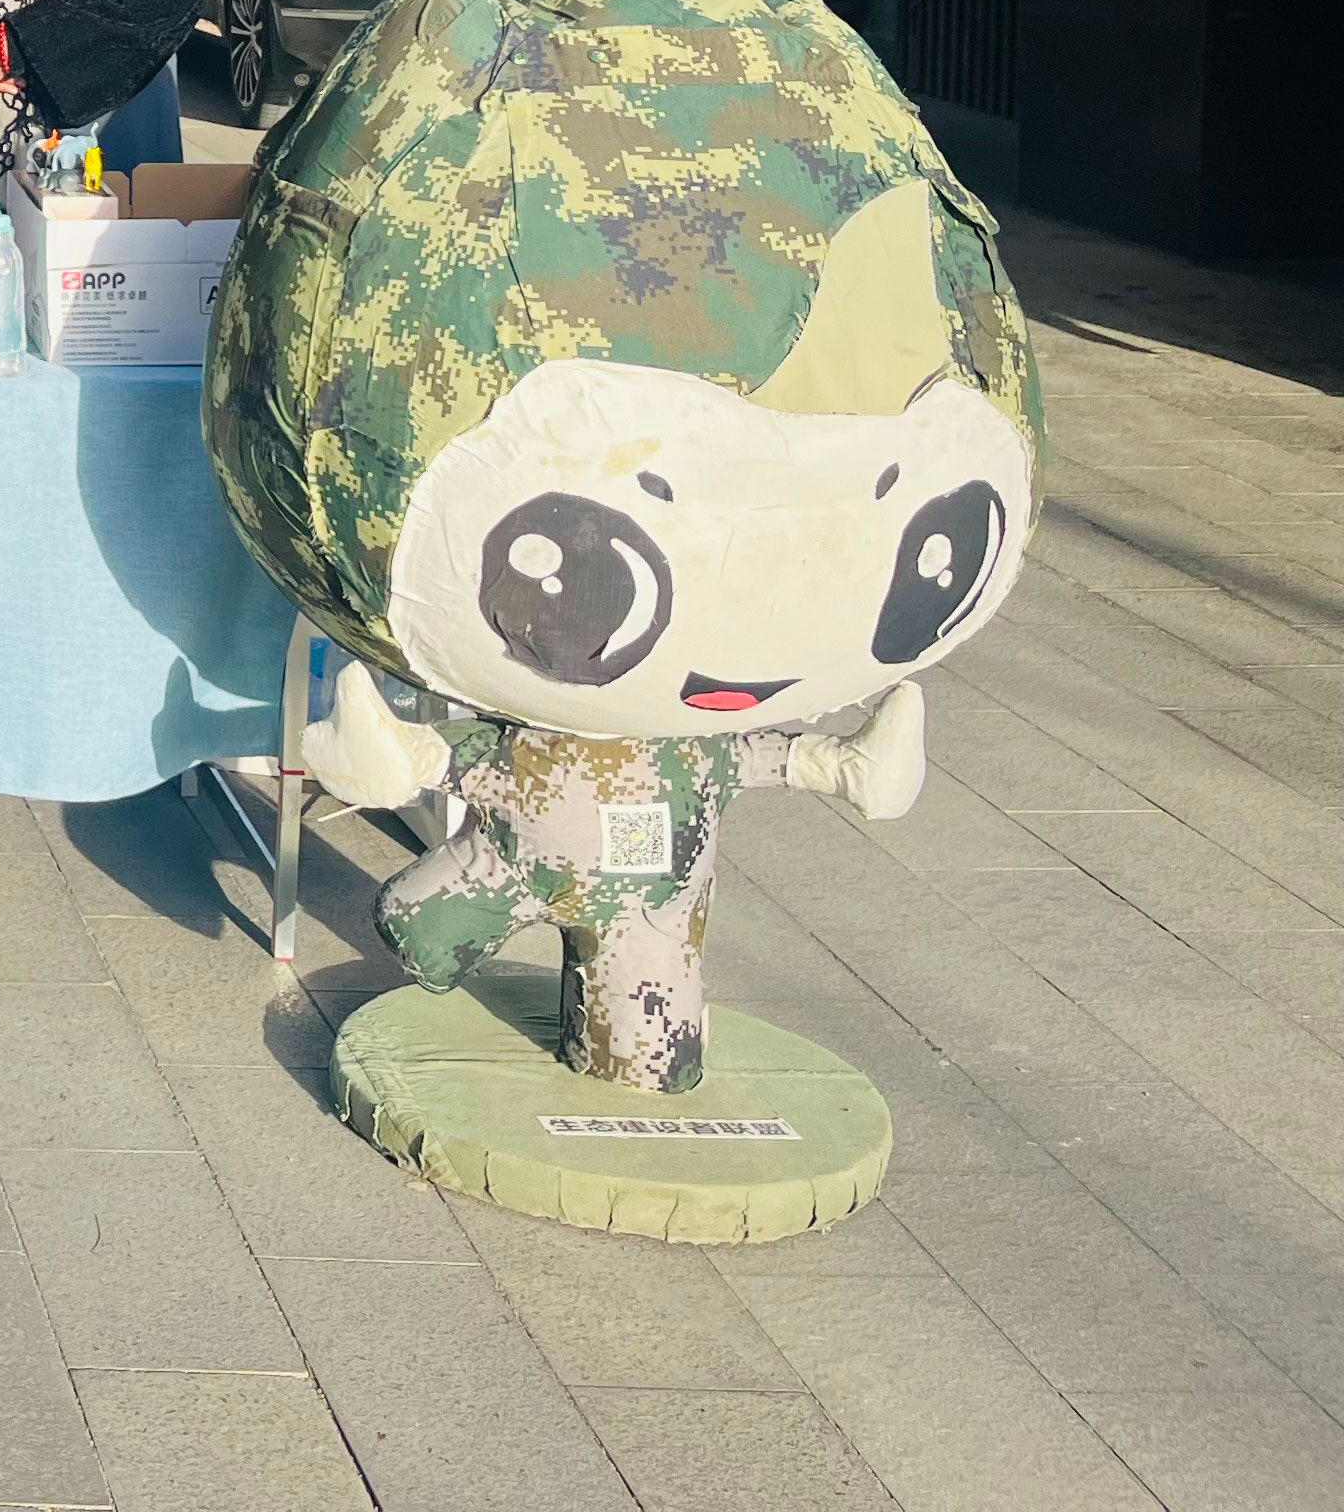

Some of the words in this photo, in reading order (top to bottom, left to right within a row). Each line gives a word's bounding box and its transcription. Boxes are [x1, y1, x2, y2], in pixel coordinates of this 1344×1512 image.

[82, 272, 126, 289] APP
[549, 1118, 790, 1136] 生态建设者联盟
